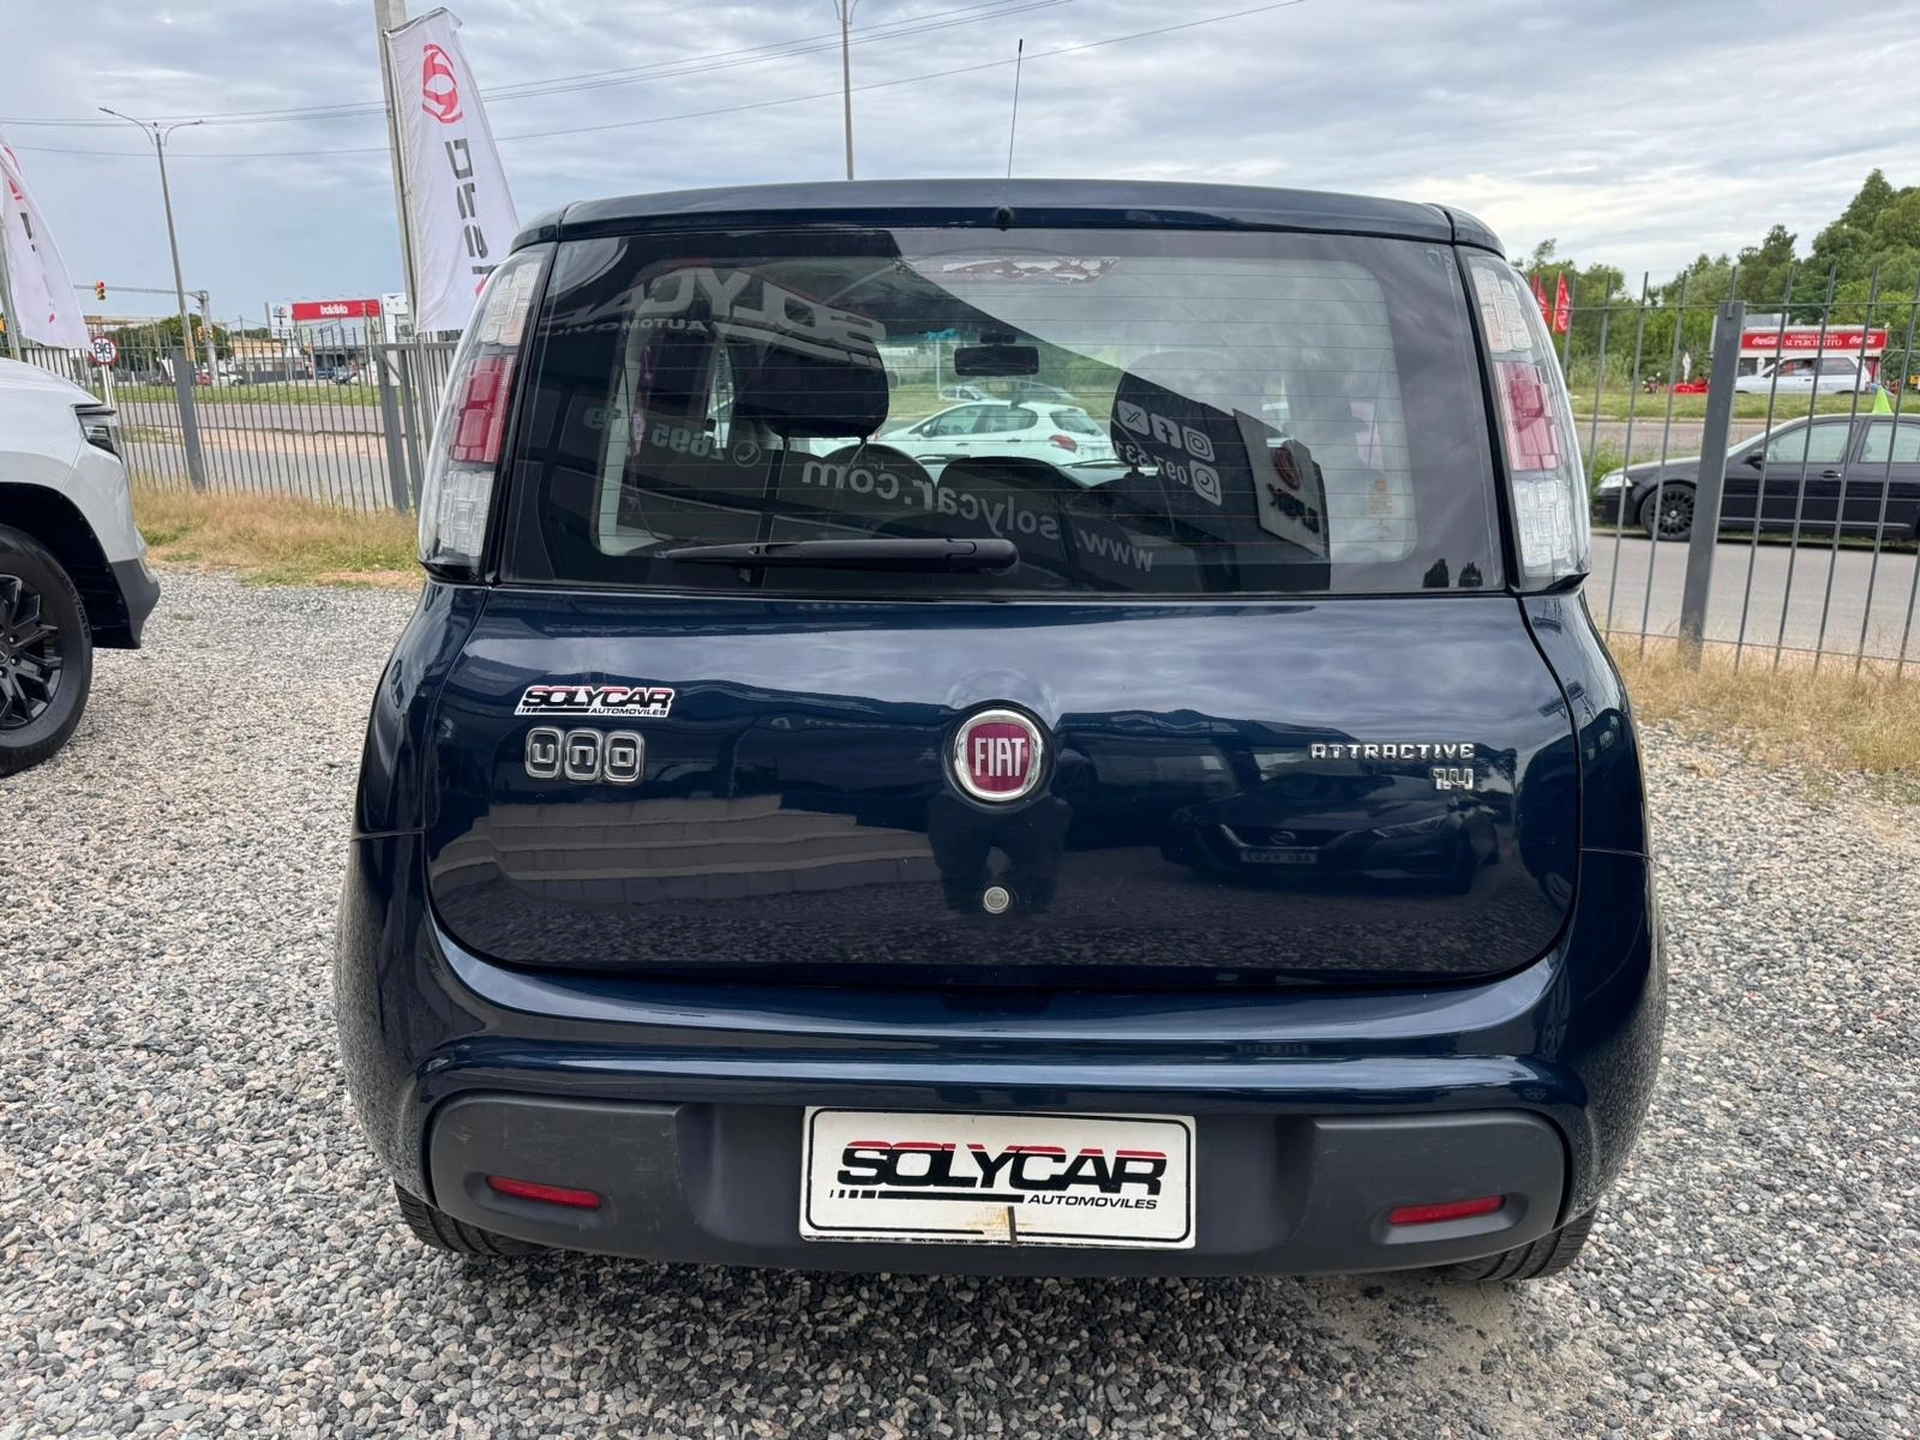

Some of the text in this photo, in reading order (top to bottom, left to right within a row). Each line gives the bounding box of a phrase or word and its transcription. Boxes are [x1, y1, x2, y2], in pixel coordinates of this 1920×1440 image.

[522, 687, 673, 708] SOLYCAR
[590, 707, 667, 716] AUTOMOVILES
[974, 737, 1026, 777] FIAT
[1310, 743, 1475, 759] ATTRACTIVE
[836, 1140, 1169, 1196] SOLYCAR
[1027, 1194, 1158, 1210] AUTOMOVILES
